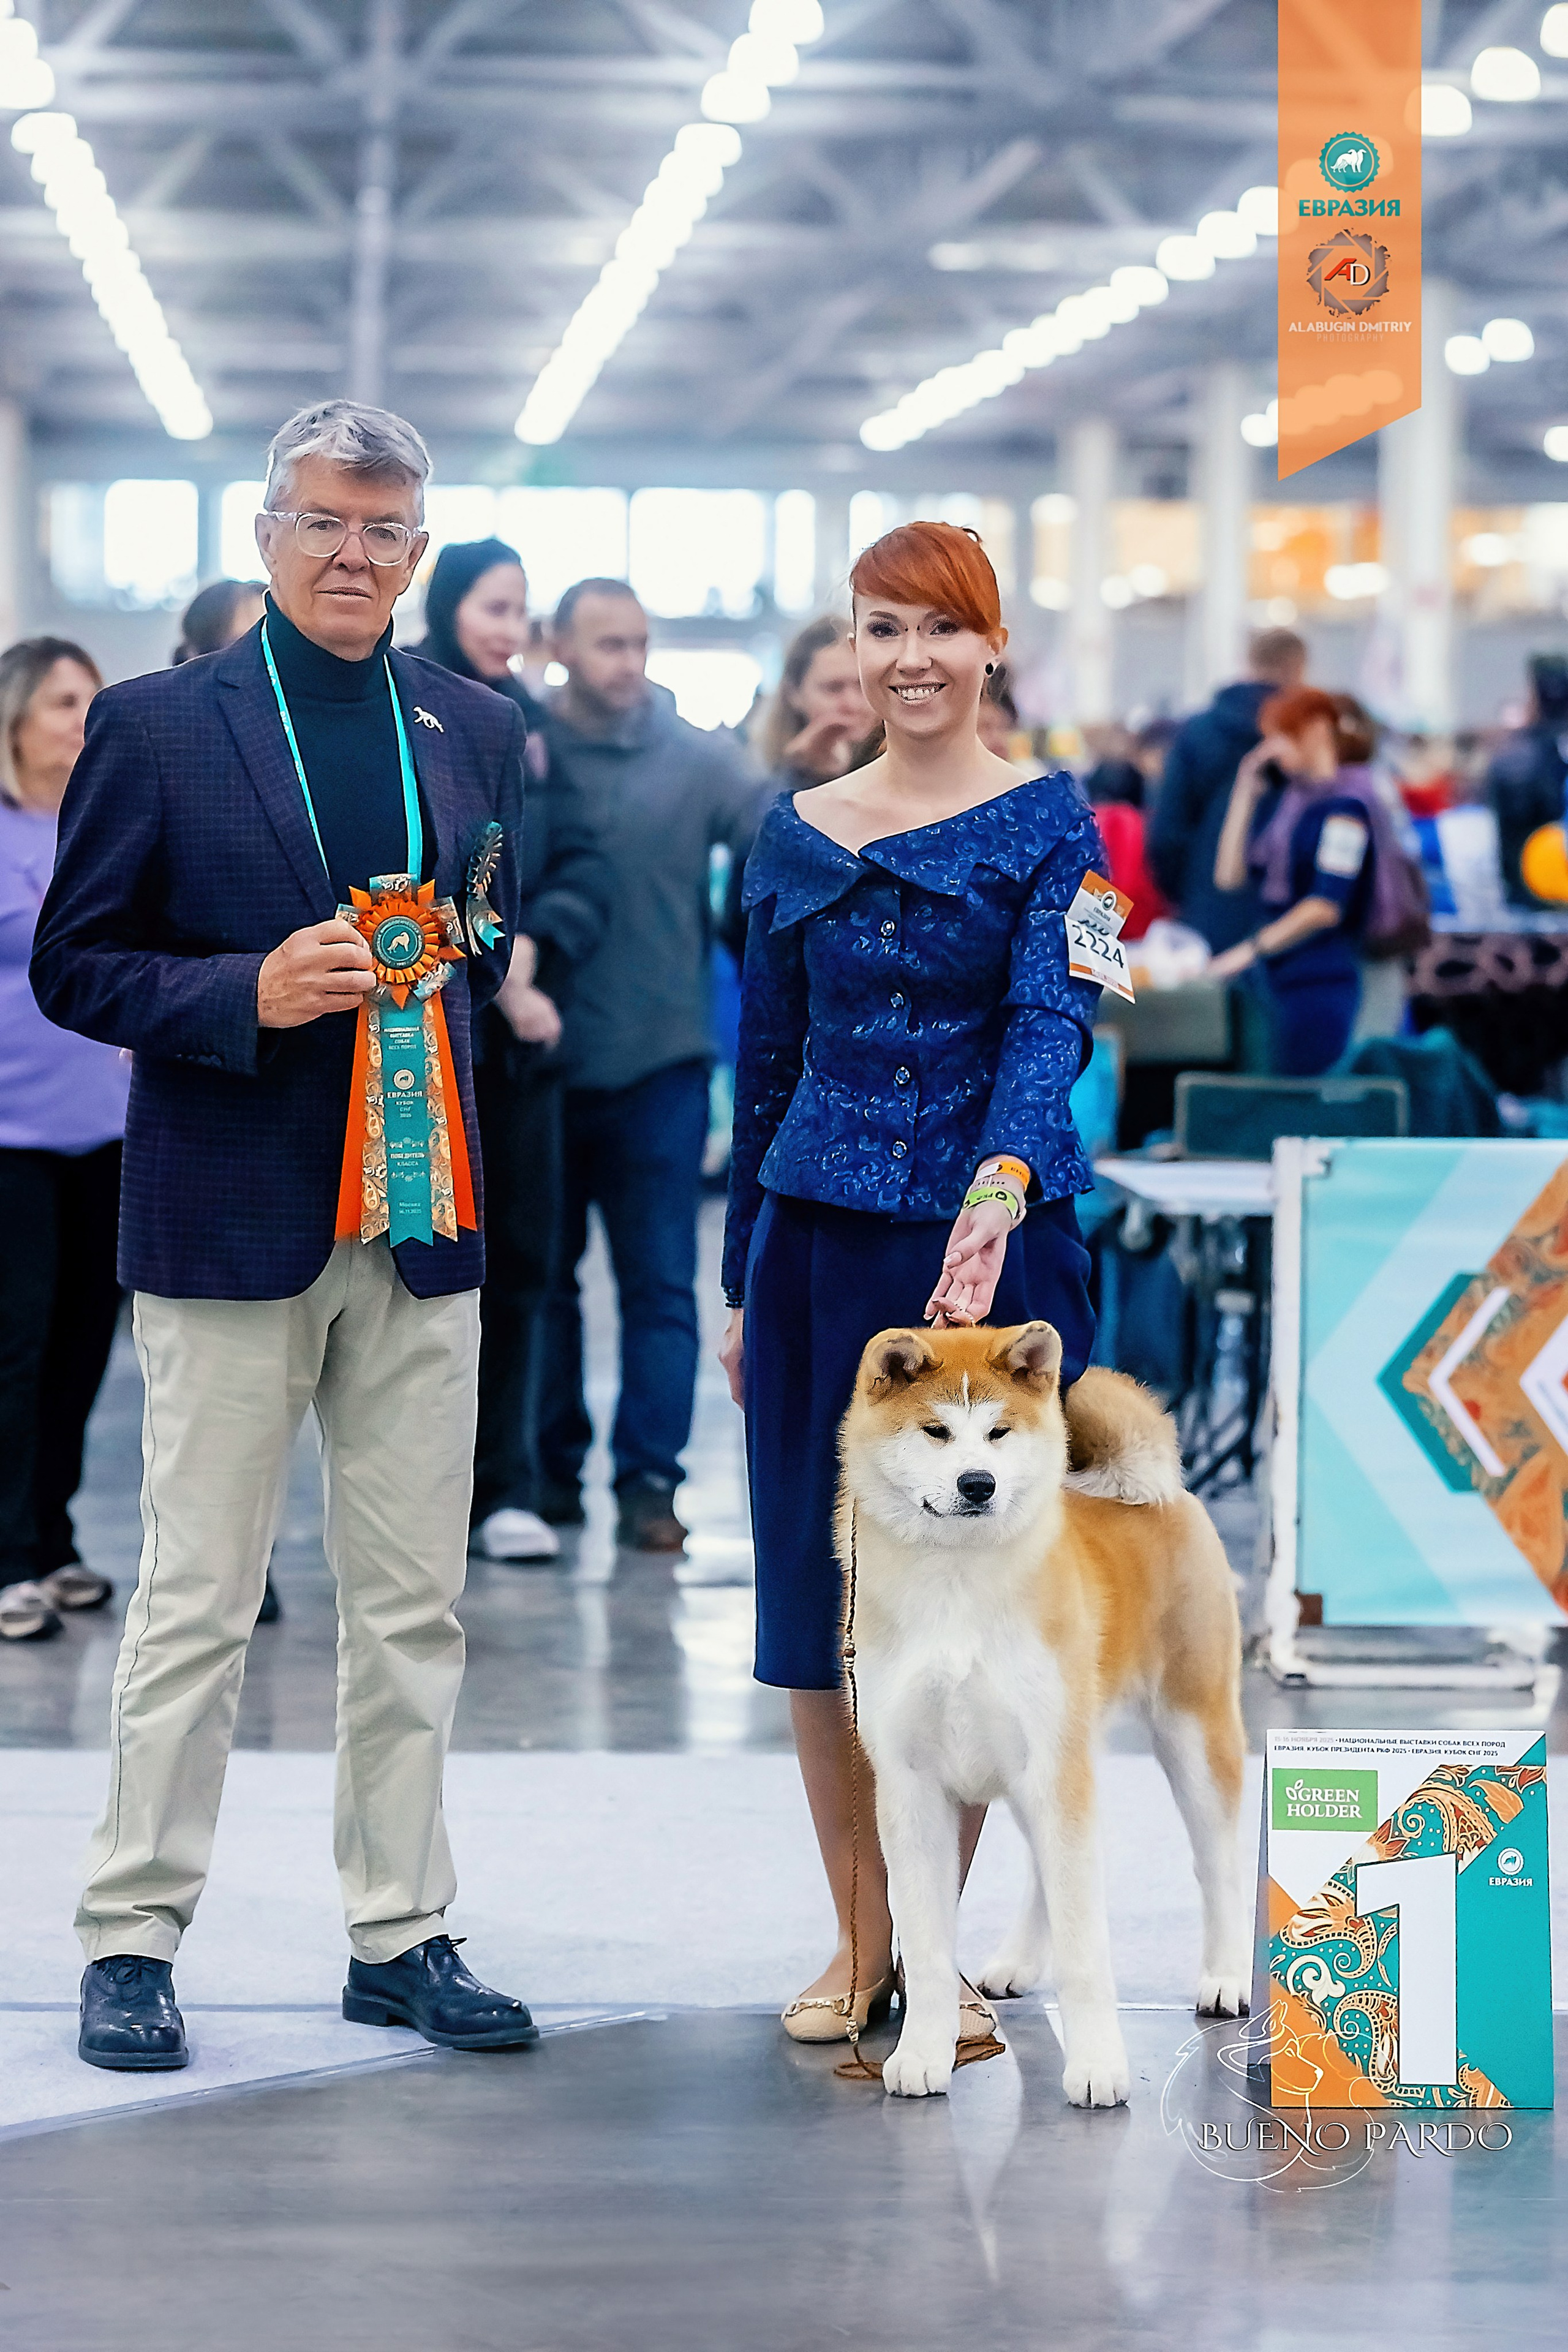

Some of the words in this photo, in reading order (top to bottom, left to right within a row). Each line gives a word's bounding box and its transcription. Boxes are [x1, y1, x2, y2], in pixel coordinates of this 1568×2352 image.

[1072, 924, 1124, 968] 2224
[1298, 1788, 1359, 1802] GREEN
[1287, 1804, 1363, 1818] HOLDER
[1489, 1877, 1532, 1887] ЕВРАЗИЯ
[1357, 1853, 1457, 2085] 1
